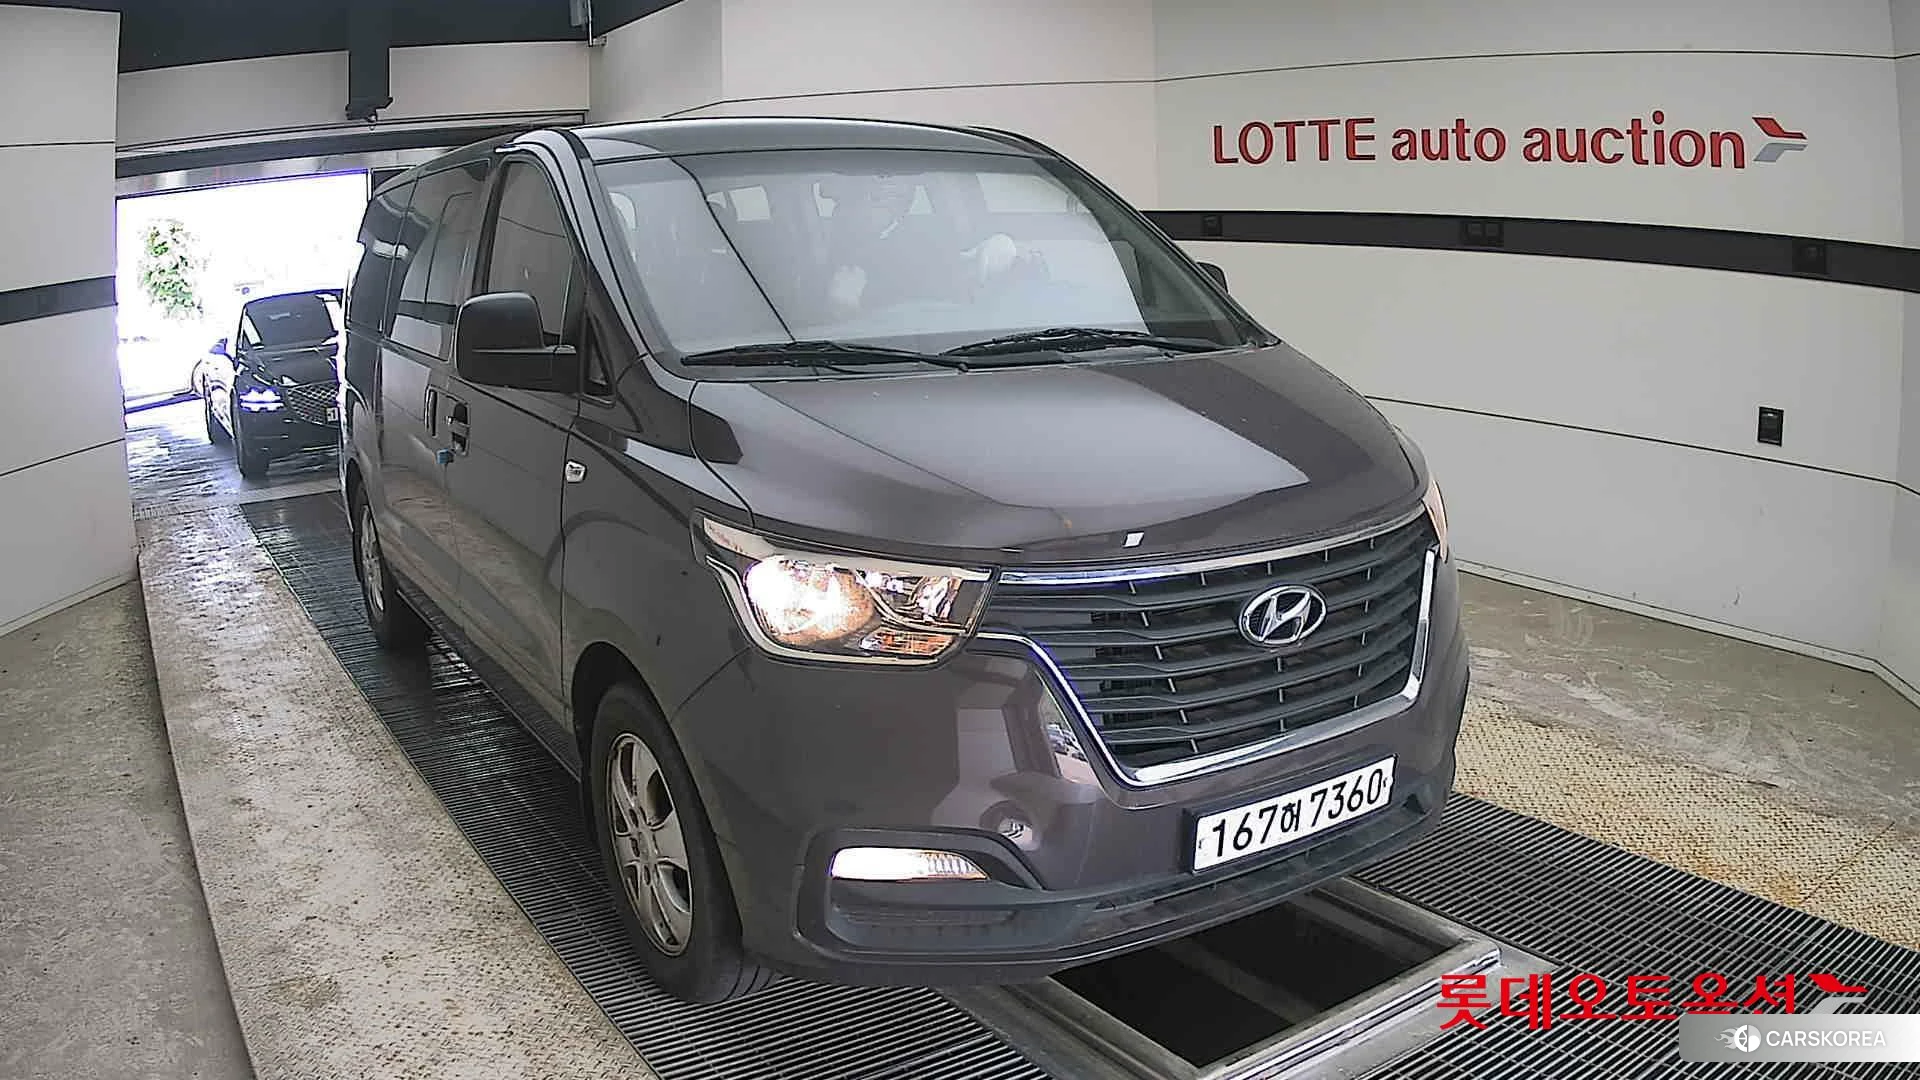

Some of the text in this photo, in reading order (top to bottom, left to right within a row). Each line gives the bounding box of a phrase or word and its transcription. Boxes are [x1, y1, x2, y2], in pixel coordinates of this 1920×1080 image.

[1213, 111, 1746, 169] LOTTE auto auction
